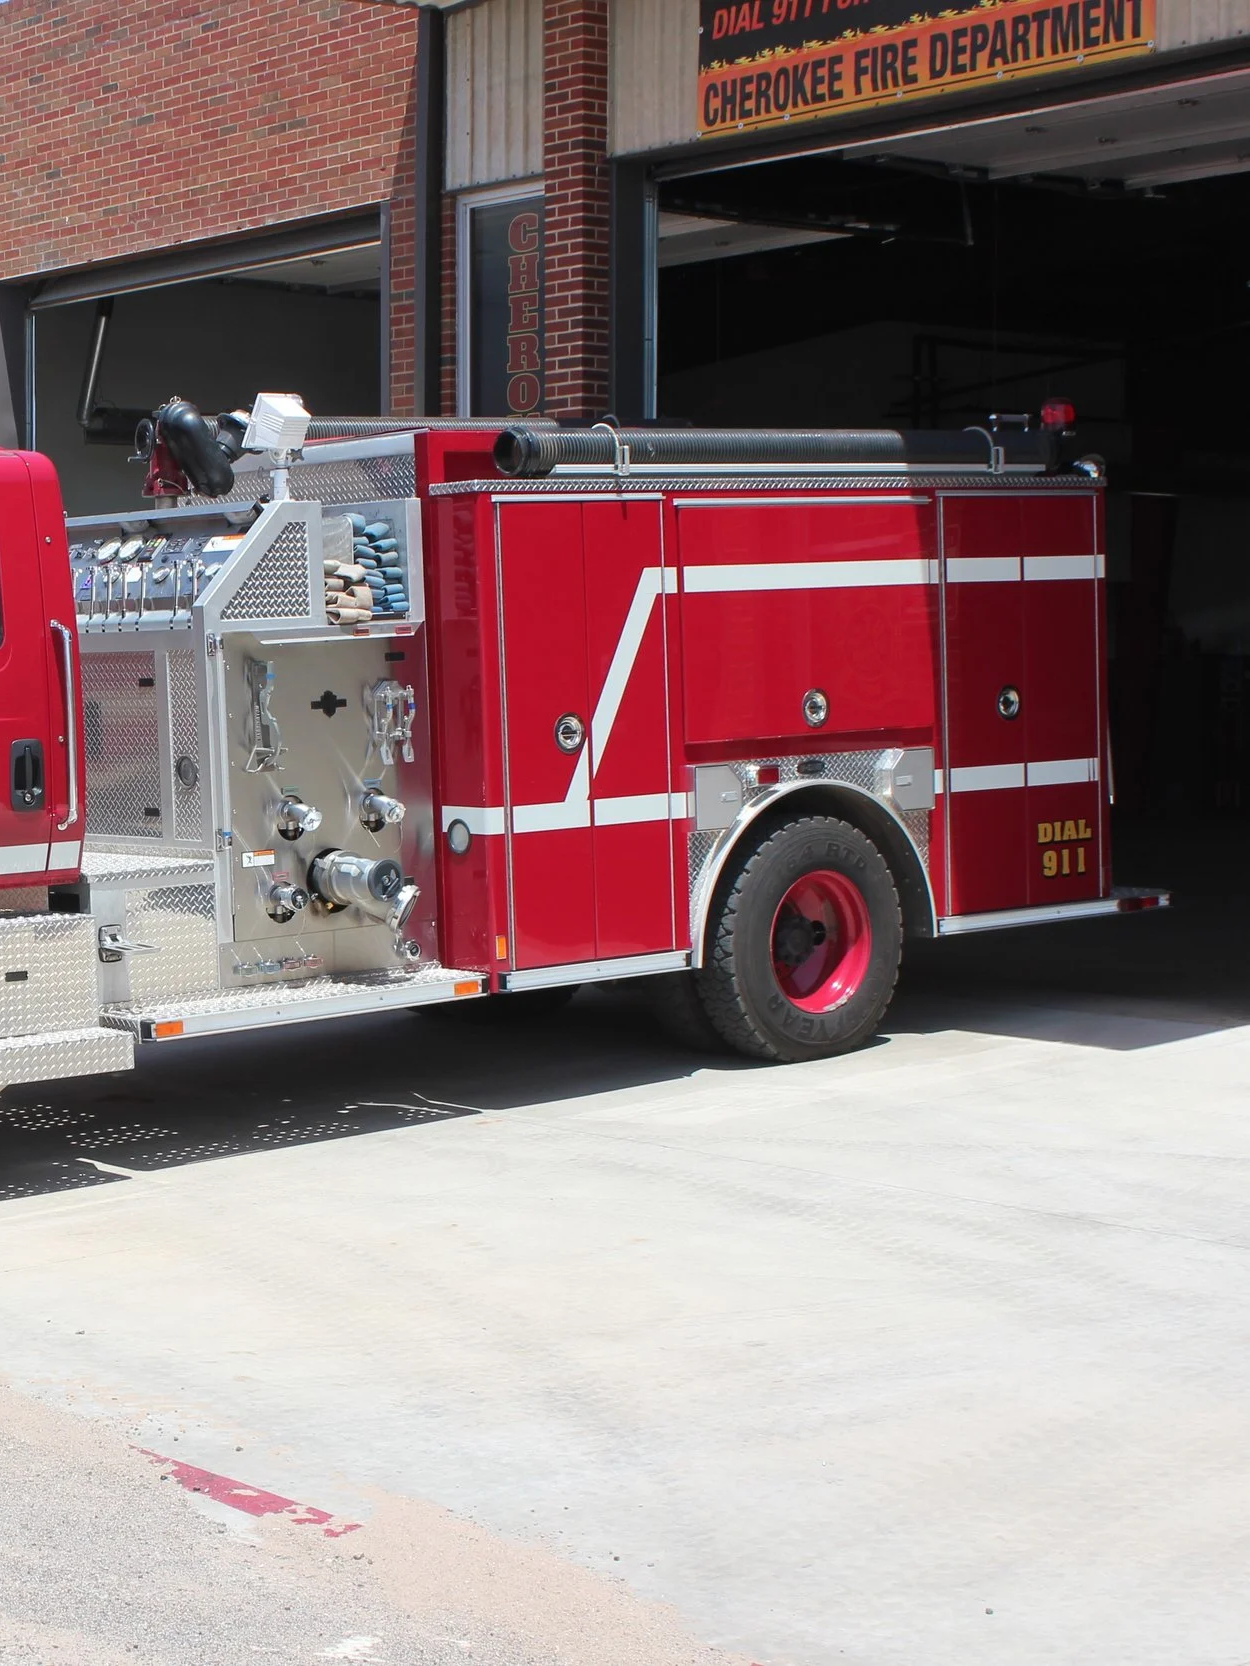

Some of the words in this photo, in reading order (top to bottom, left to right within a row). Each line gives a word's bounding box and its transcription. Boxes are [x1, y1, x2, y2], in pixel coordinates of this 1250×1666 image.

[712, 0, 765, 40] DIAL
[772, 0, 814, 25] 911
[703, 54, 844, 127] CHEROKEE
[854, 38, 918, 95] FIRE
[928, 0, 1142, 80] DEPARTMENT
[506, 212, 541, 417] CHERO
[1037, 818, 1093, 844] DIAL
[1042, 846, 1087, 877] 911
